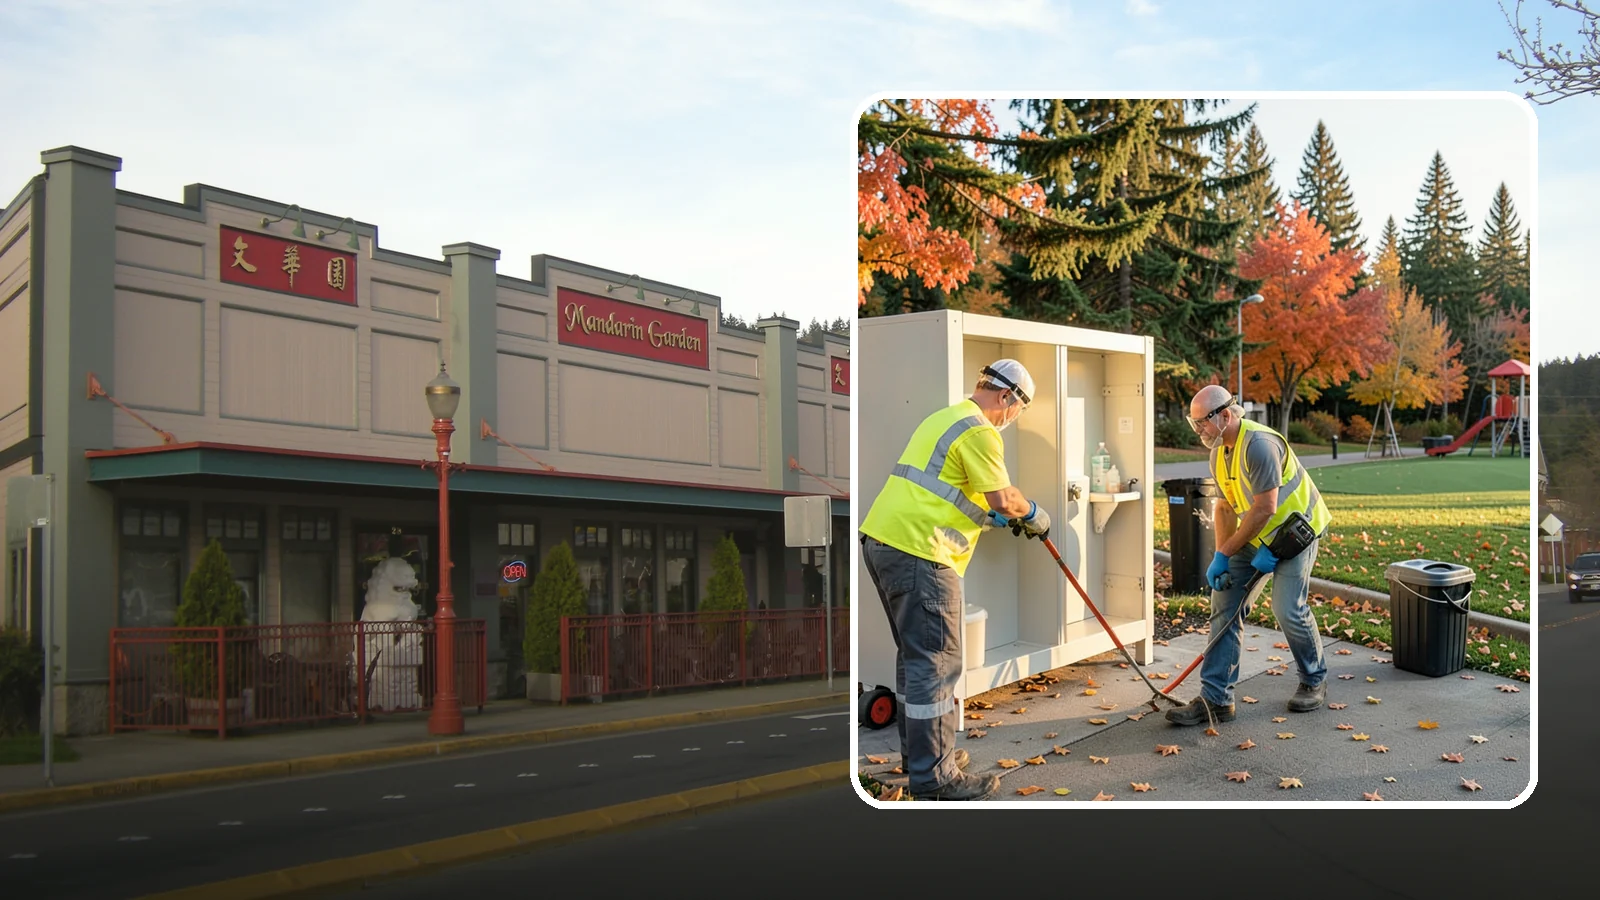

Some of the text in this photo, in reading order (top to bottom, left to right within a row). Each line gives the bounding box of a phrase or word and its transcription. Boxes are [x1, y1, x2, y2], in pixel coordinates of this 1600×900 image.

[230, 235, 346, 291] 文華園
[564, 302, 701, 352] Mandarin Garden
[503, 565, 527, 578] OPEN
